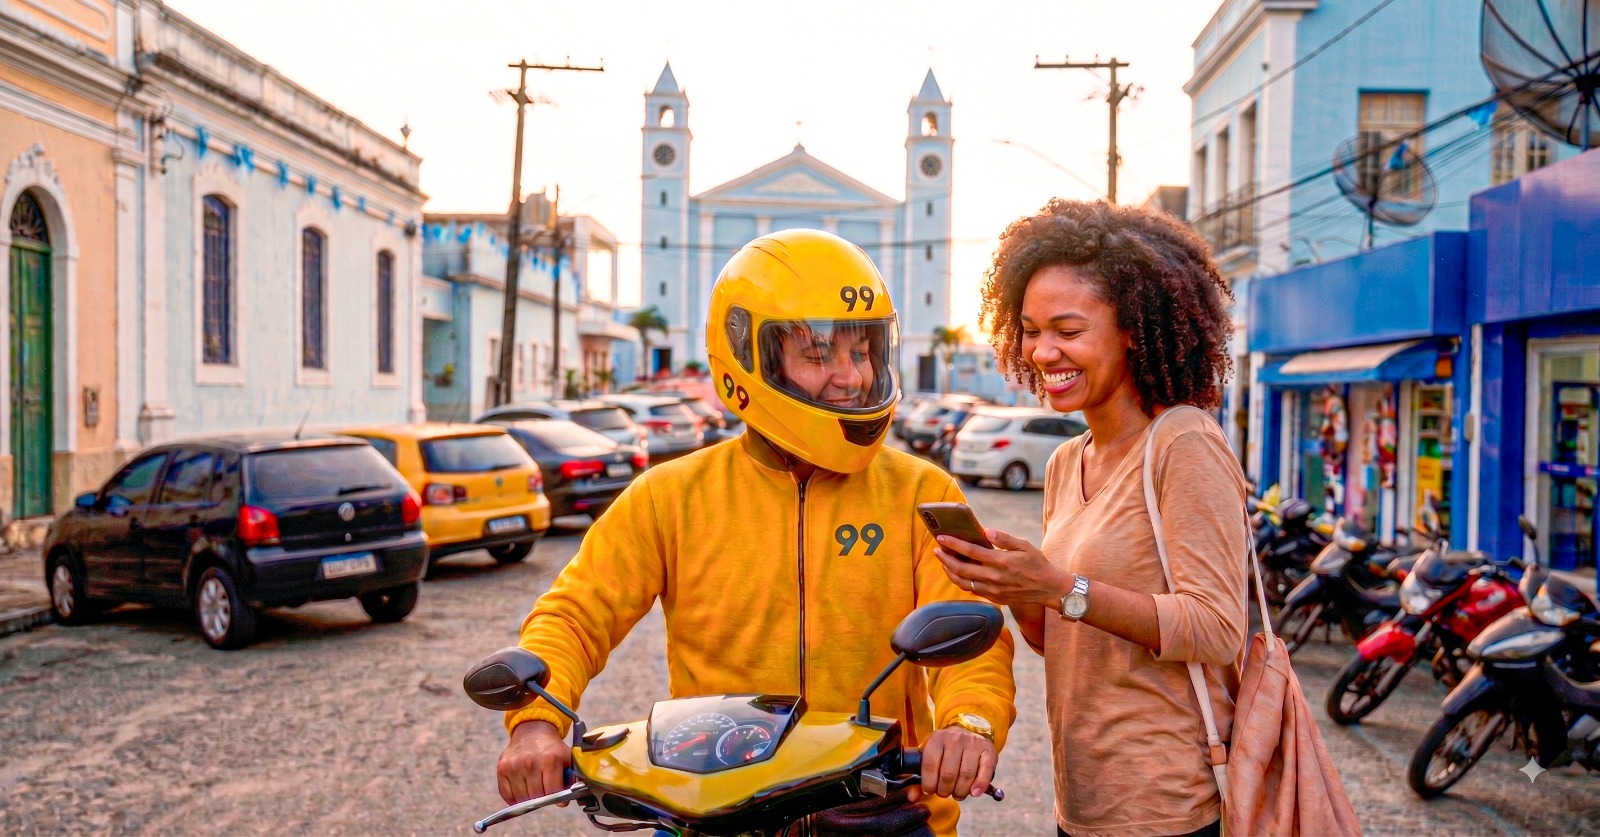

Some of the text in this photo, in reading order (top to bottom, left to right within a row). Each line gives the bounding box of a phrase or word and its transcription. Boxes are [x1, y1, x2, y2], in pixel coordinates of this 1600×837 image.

[840, 286, 875, 312] 99
[723, 373, 750, 411] 99
[835, 523, 885, 556] 99
